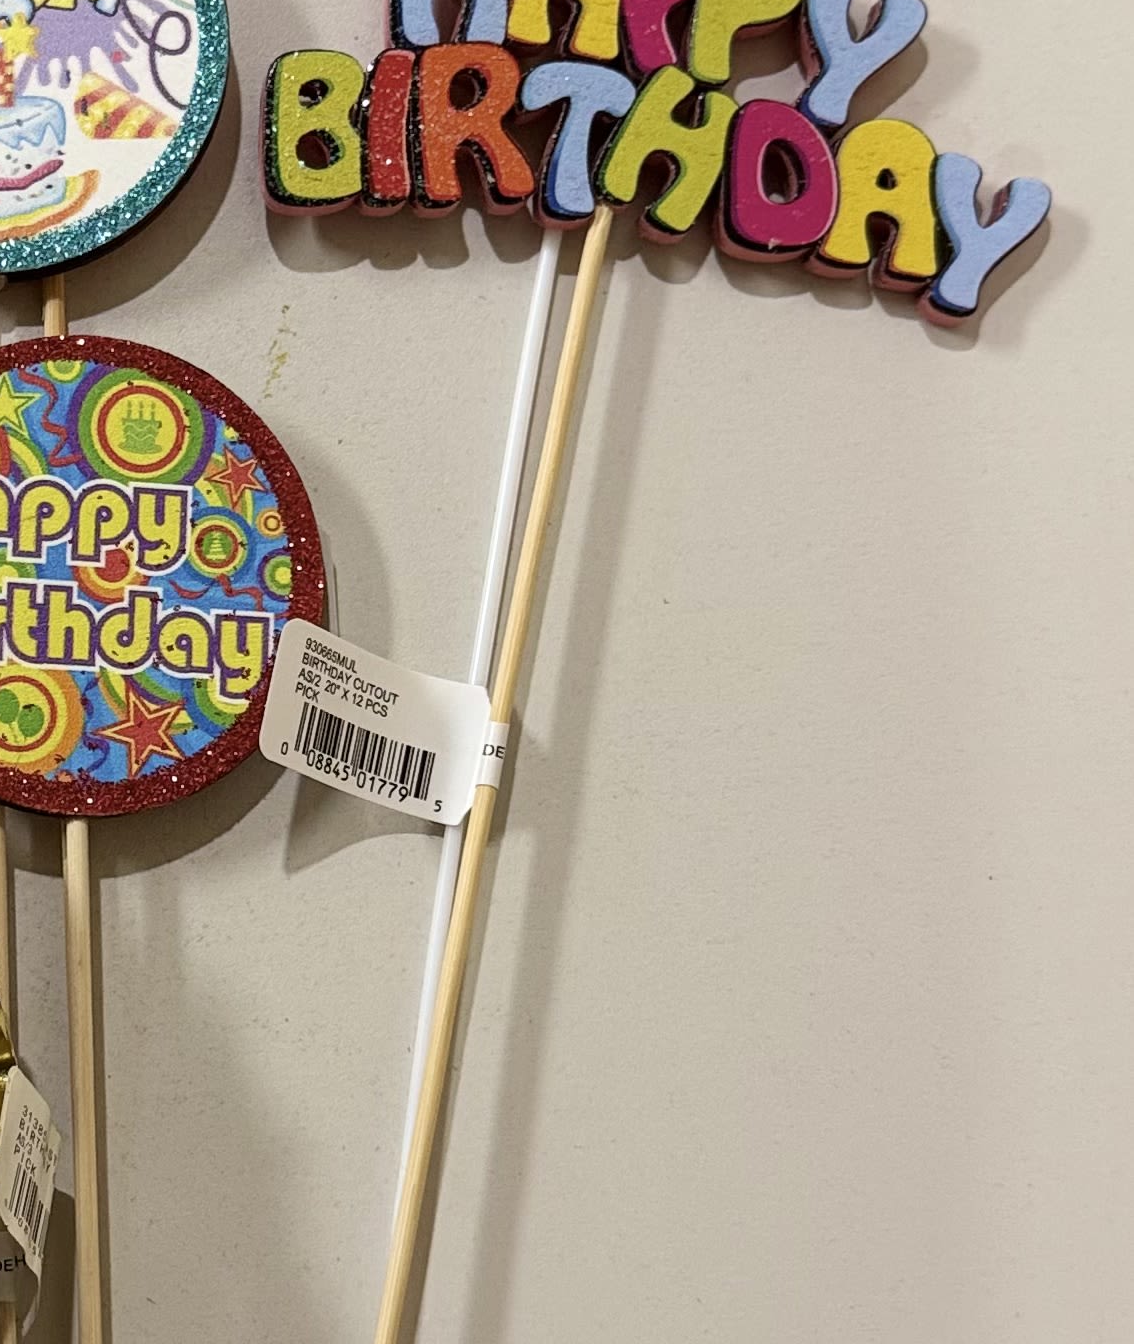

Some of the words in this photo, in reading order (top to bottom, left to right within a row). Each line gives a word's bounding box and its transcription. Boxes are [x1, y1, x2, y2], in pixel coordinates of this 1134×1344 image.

[264, 43, 1052, 324] BIRTHDAY
[295, 682, 320, 703] PICK
[298, 668, 320, 687] AS/2
[340, 687, 349, 701] X
[352, 693, 363, 707] 12
[365, 698, 388, 718] PCS
[301, 652, 353, 690] BIRTHDAY
[353, 679, 399, 706] CUTOUT
[280, 741, 289, 755] 0
[306, 750, 350, 781] 08845
[356, 771, 408, 803] 01779
[434, 799, 442, 812] 5
[13, 1143, 37, 1177] PICK
